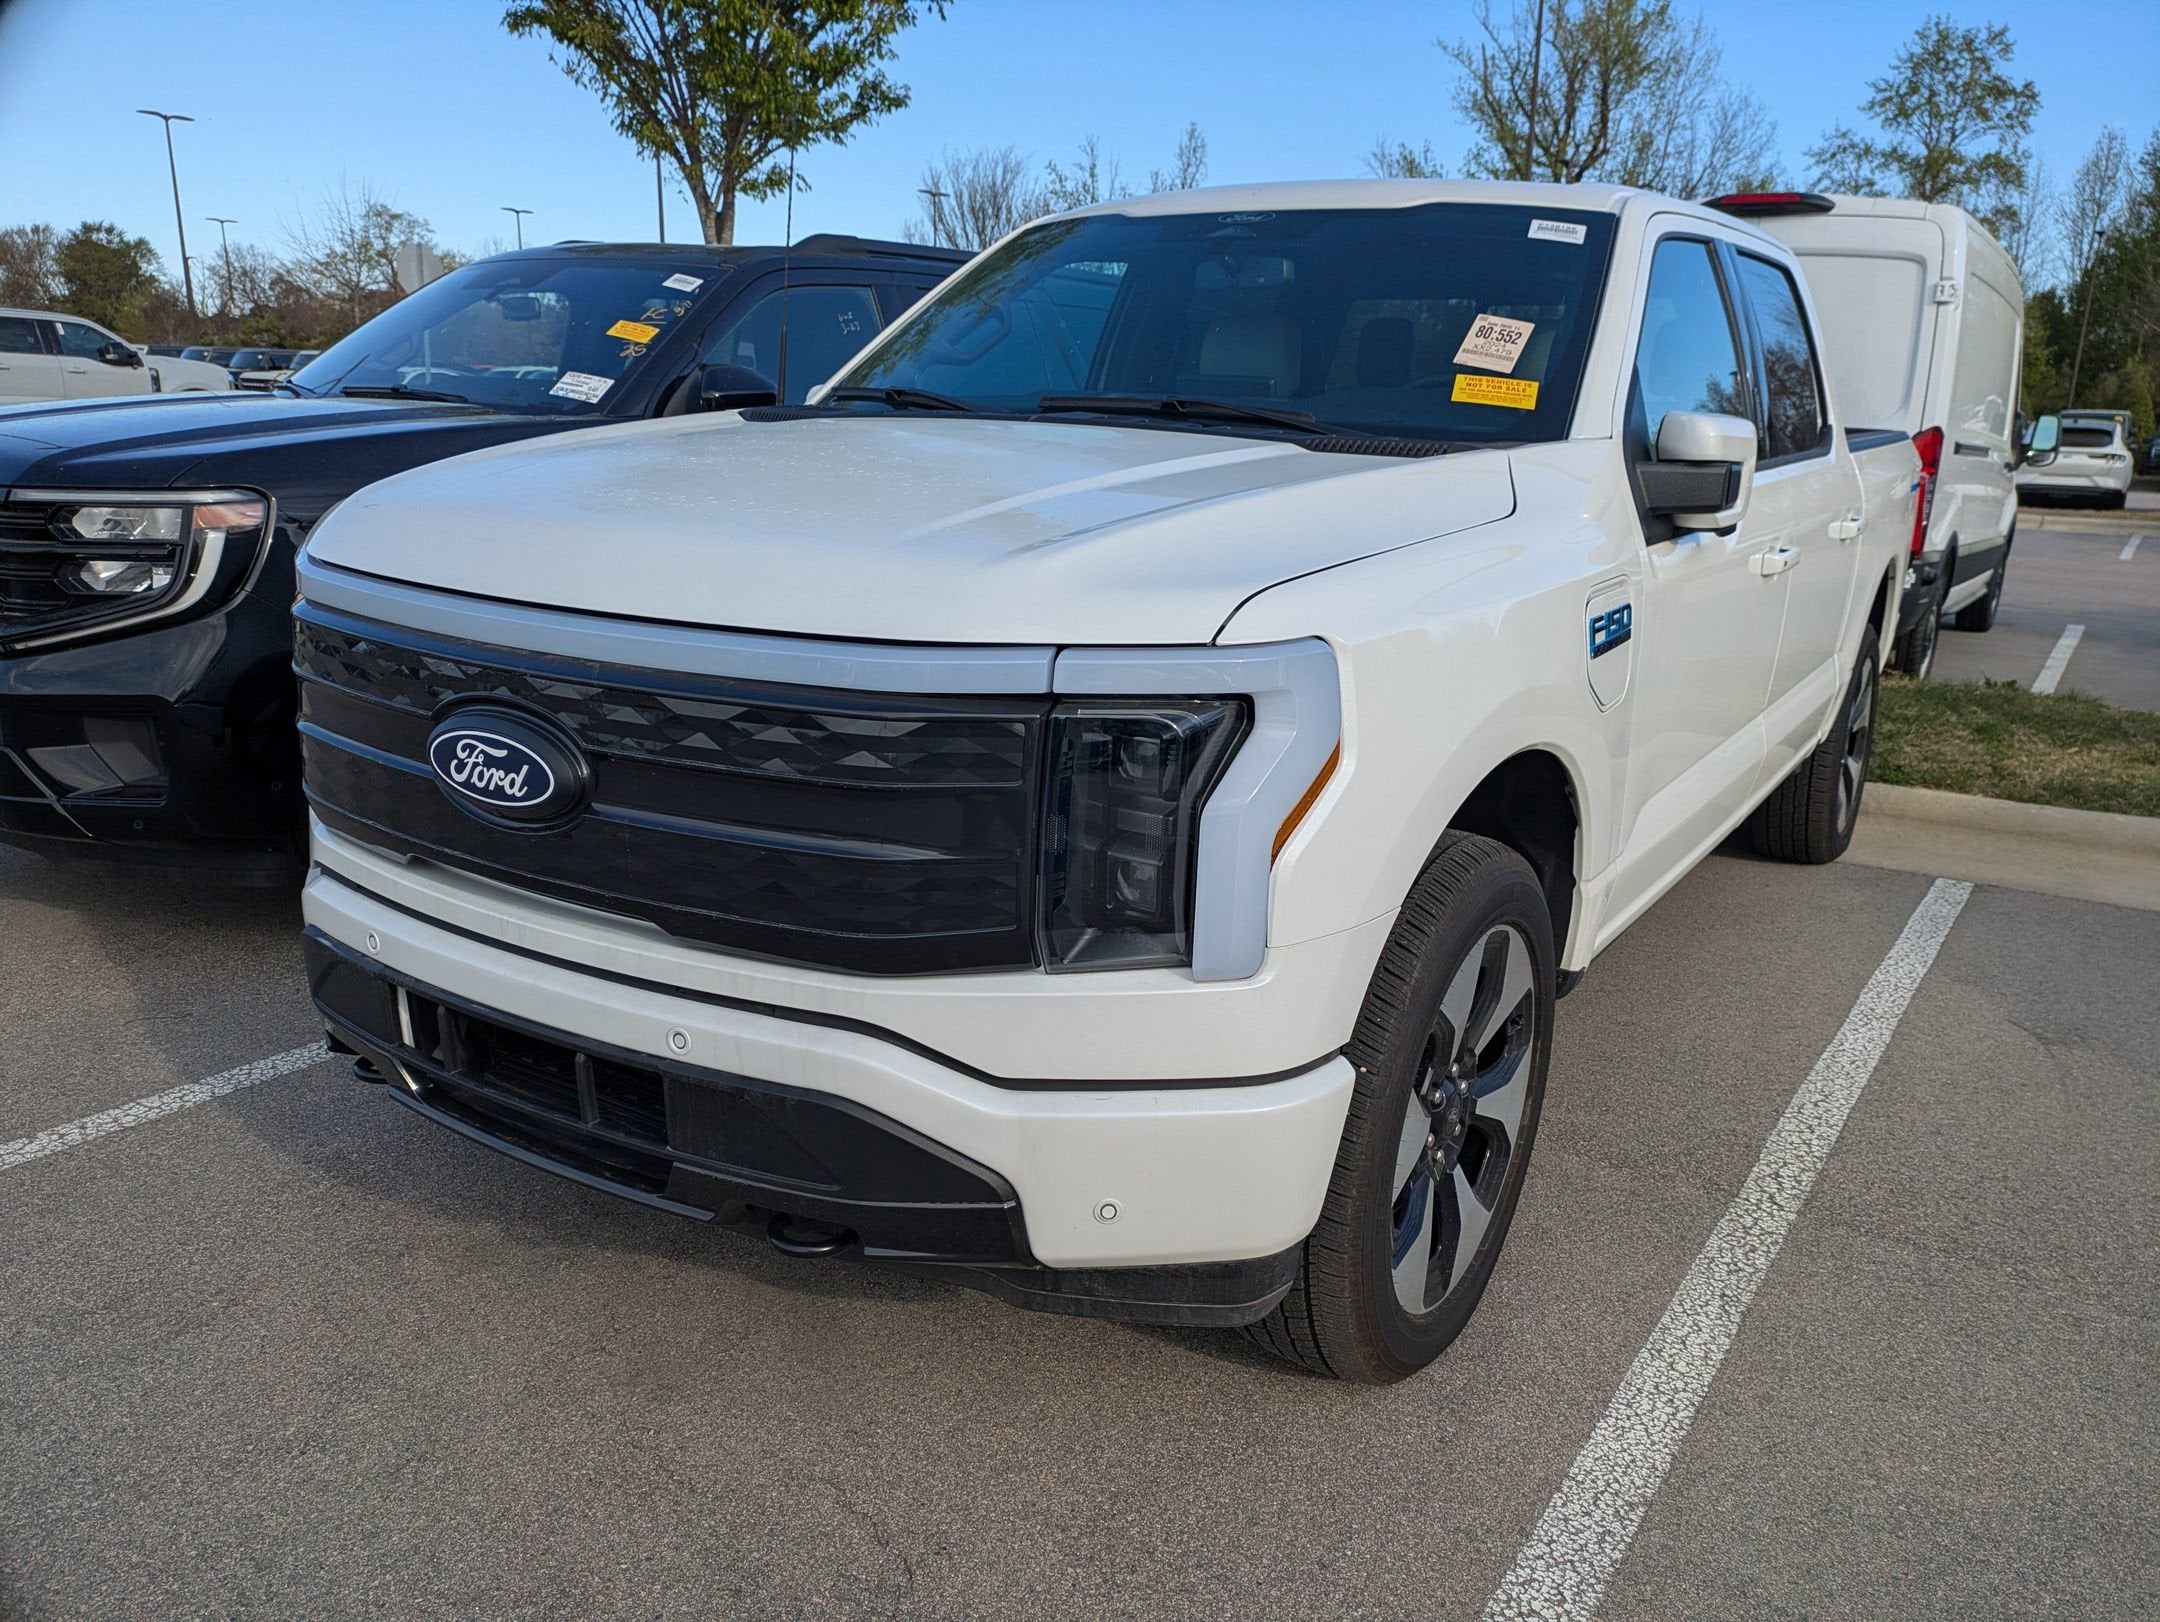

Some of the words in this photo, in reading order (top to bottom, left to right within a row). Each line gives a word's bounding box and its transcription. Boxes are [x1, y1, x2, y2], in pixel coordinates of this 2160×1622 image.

[1475, 325, 1523, 345] 80:552
[1485, 377, 1521, 387] VEHICLE
[450, 738, 530, 798] Ford
